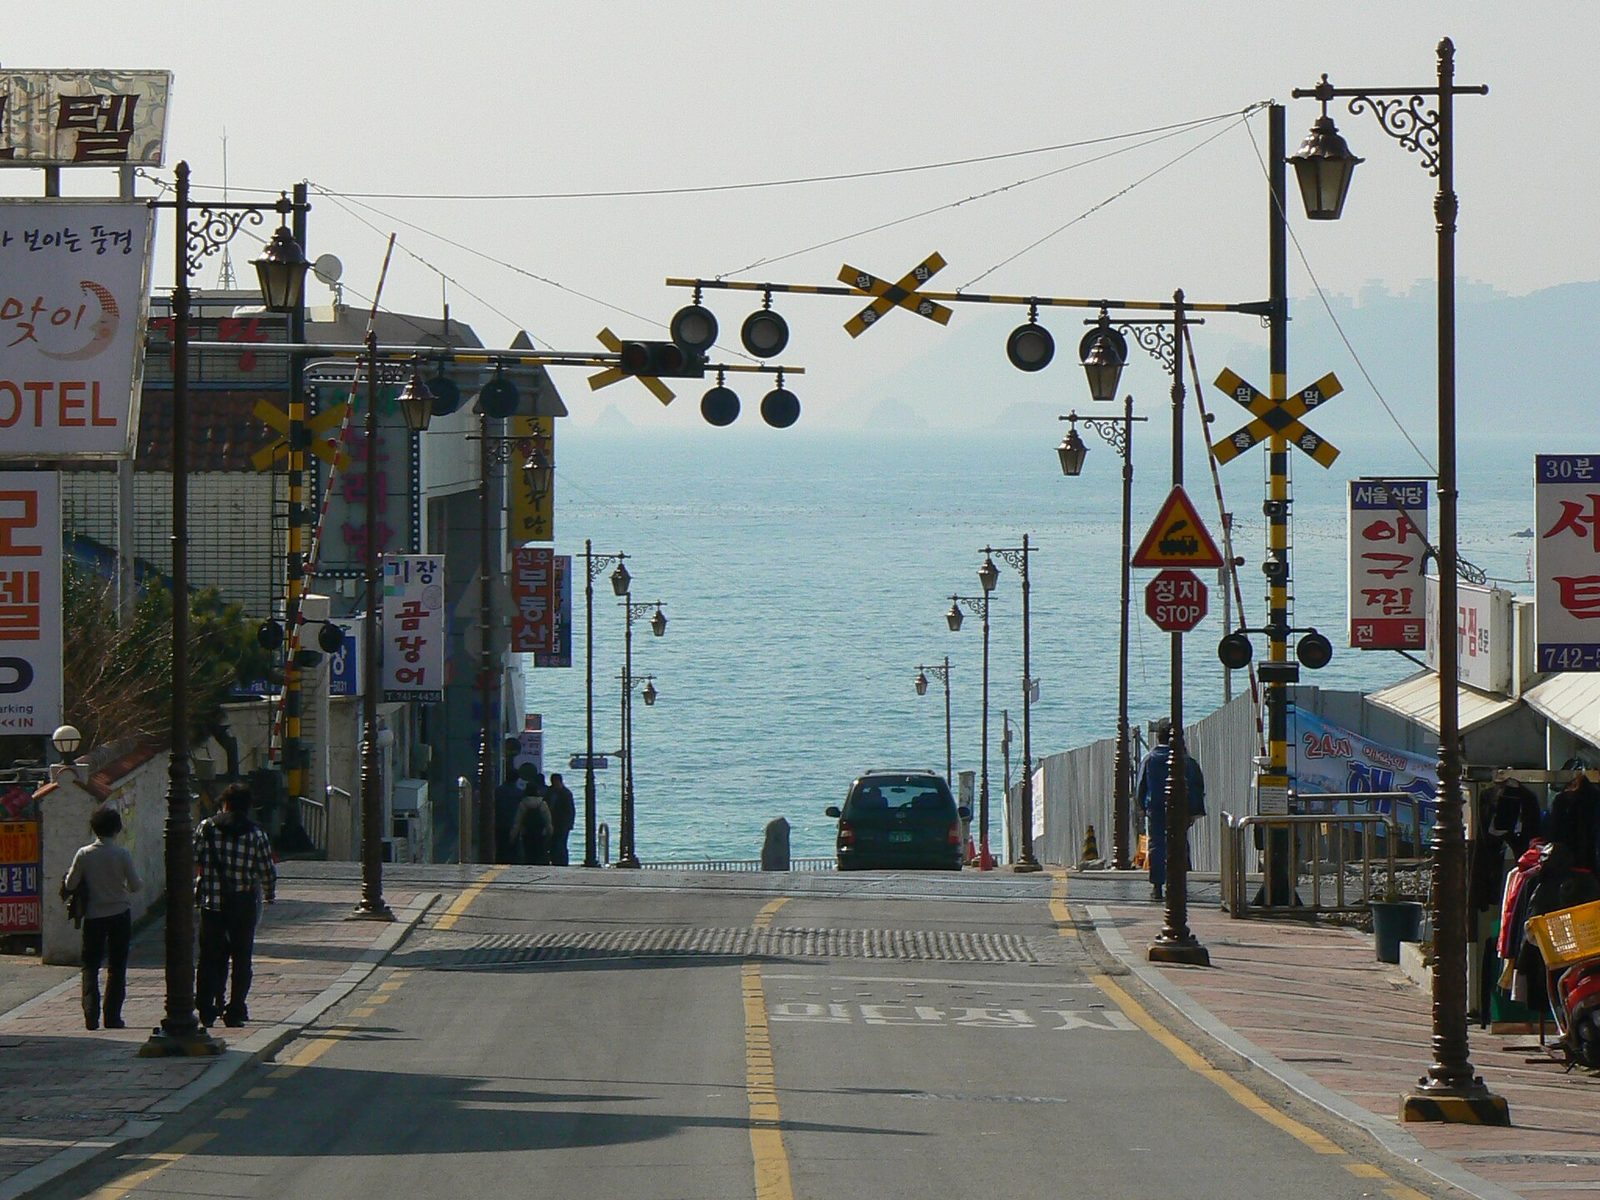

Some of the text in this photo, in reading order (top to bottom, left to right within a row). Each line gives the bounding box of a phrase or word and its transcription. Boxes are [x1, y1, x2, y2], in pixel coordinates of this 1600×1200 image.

[0, 94, 140, 162] 텔
[23, 226, 83, 253] 보이는
[91, 225, 132, 255] 풍경
[1355, 486, 1424, 504] 서울 식당
[387, 560, 438, 584] 기장
[1361, 516, 1419, 616] 아구찜
[1155, 580, 1198, 602] 정지
[1156, 605, 1201, 623] STOP
[18, 718, 34, 728] IN
